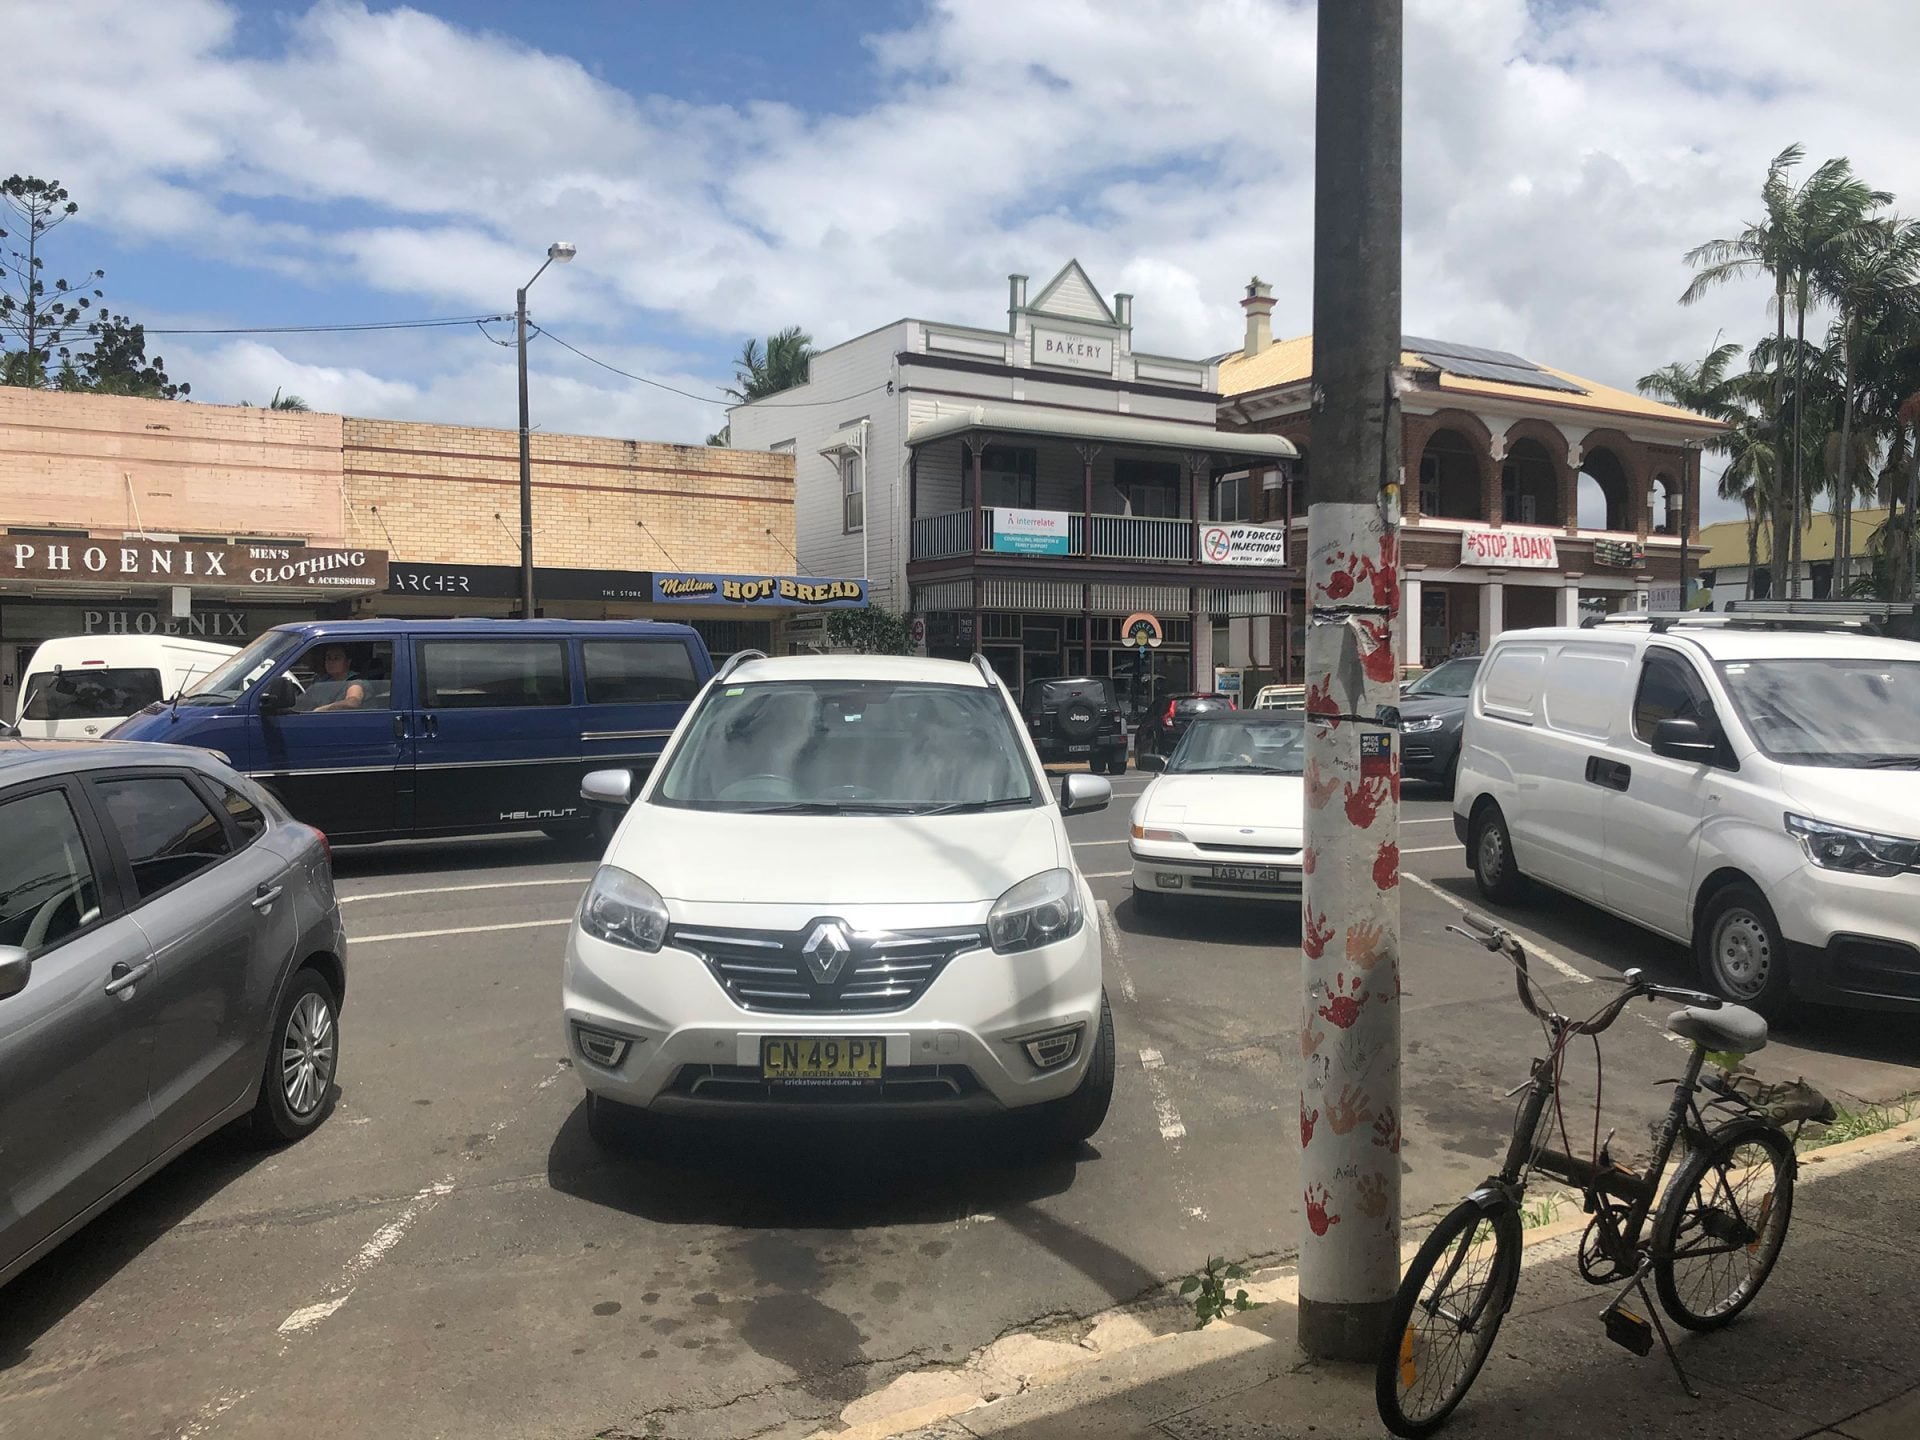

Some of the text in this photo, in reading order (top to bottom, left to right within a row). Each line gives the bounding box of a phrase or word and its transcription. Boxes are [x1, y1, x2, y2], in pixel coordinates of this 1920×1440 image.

[1046, 339, 1102, 359] BAKERY
[1016, 517, 1055, 527] interrelate
[1230, 529, 1282, 541] NO FORCED
[1230, 542, 1282, 552] INJECTIONS
[1467, 534, 1507, 558] #STOP
[14, 543, 227, 576] PHOENIX
[249, 548, 290, 560] MEN'S
[249, 551, 366, 583] CLOTHING
[317, 576, 377, 586] ACCESSORIES
[396, 574, 470, 592] ARCHER
[620, 590, 642, 598] STORE
[658, 577, 862, 601] Mullum HOT BREAD
[84, 611, 247, 635] PHOENIX
[1130, 621, 1154, 636] TINKER
[1070, 713, 1090, 723] Jeep
[500, 808, 577, 820] HELMUT
